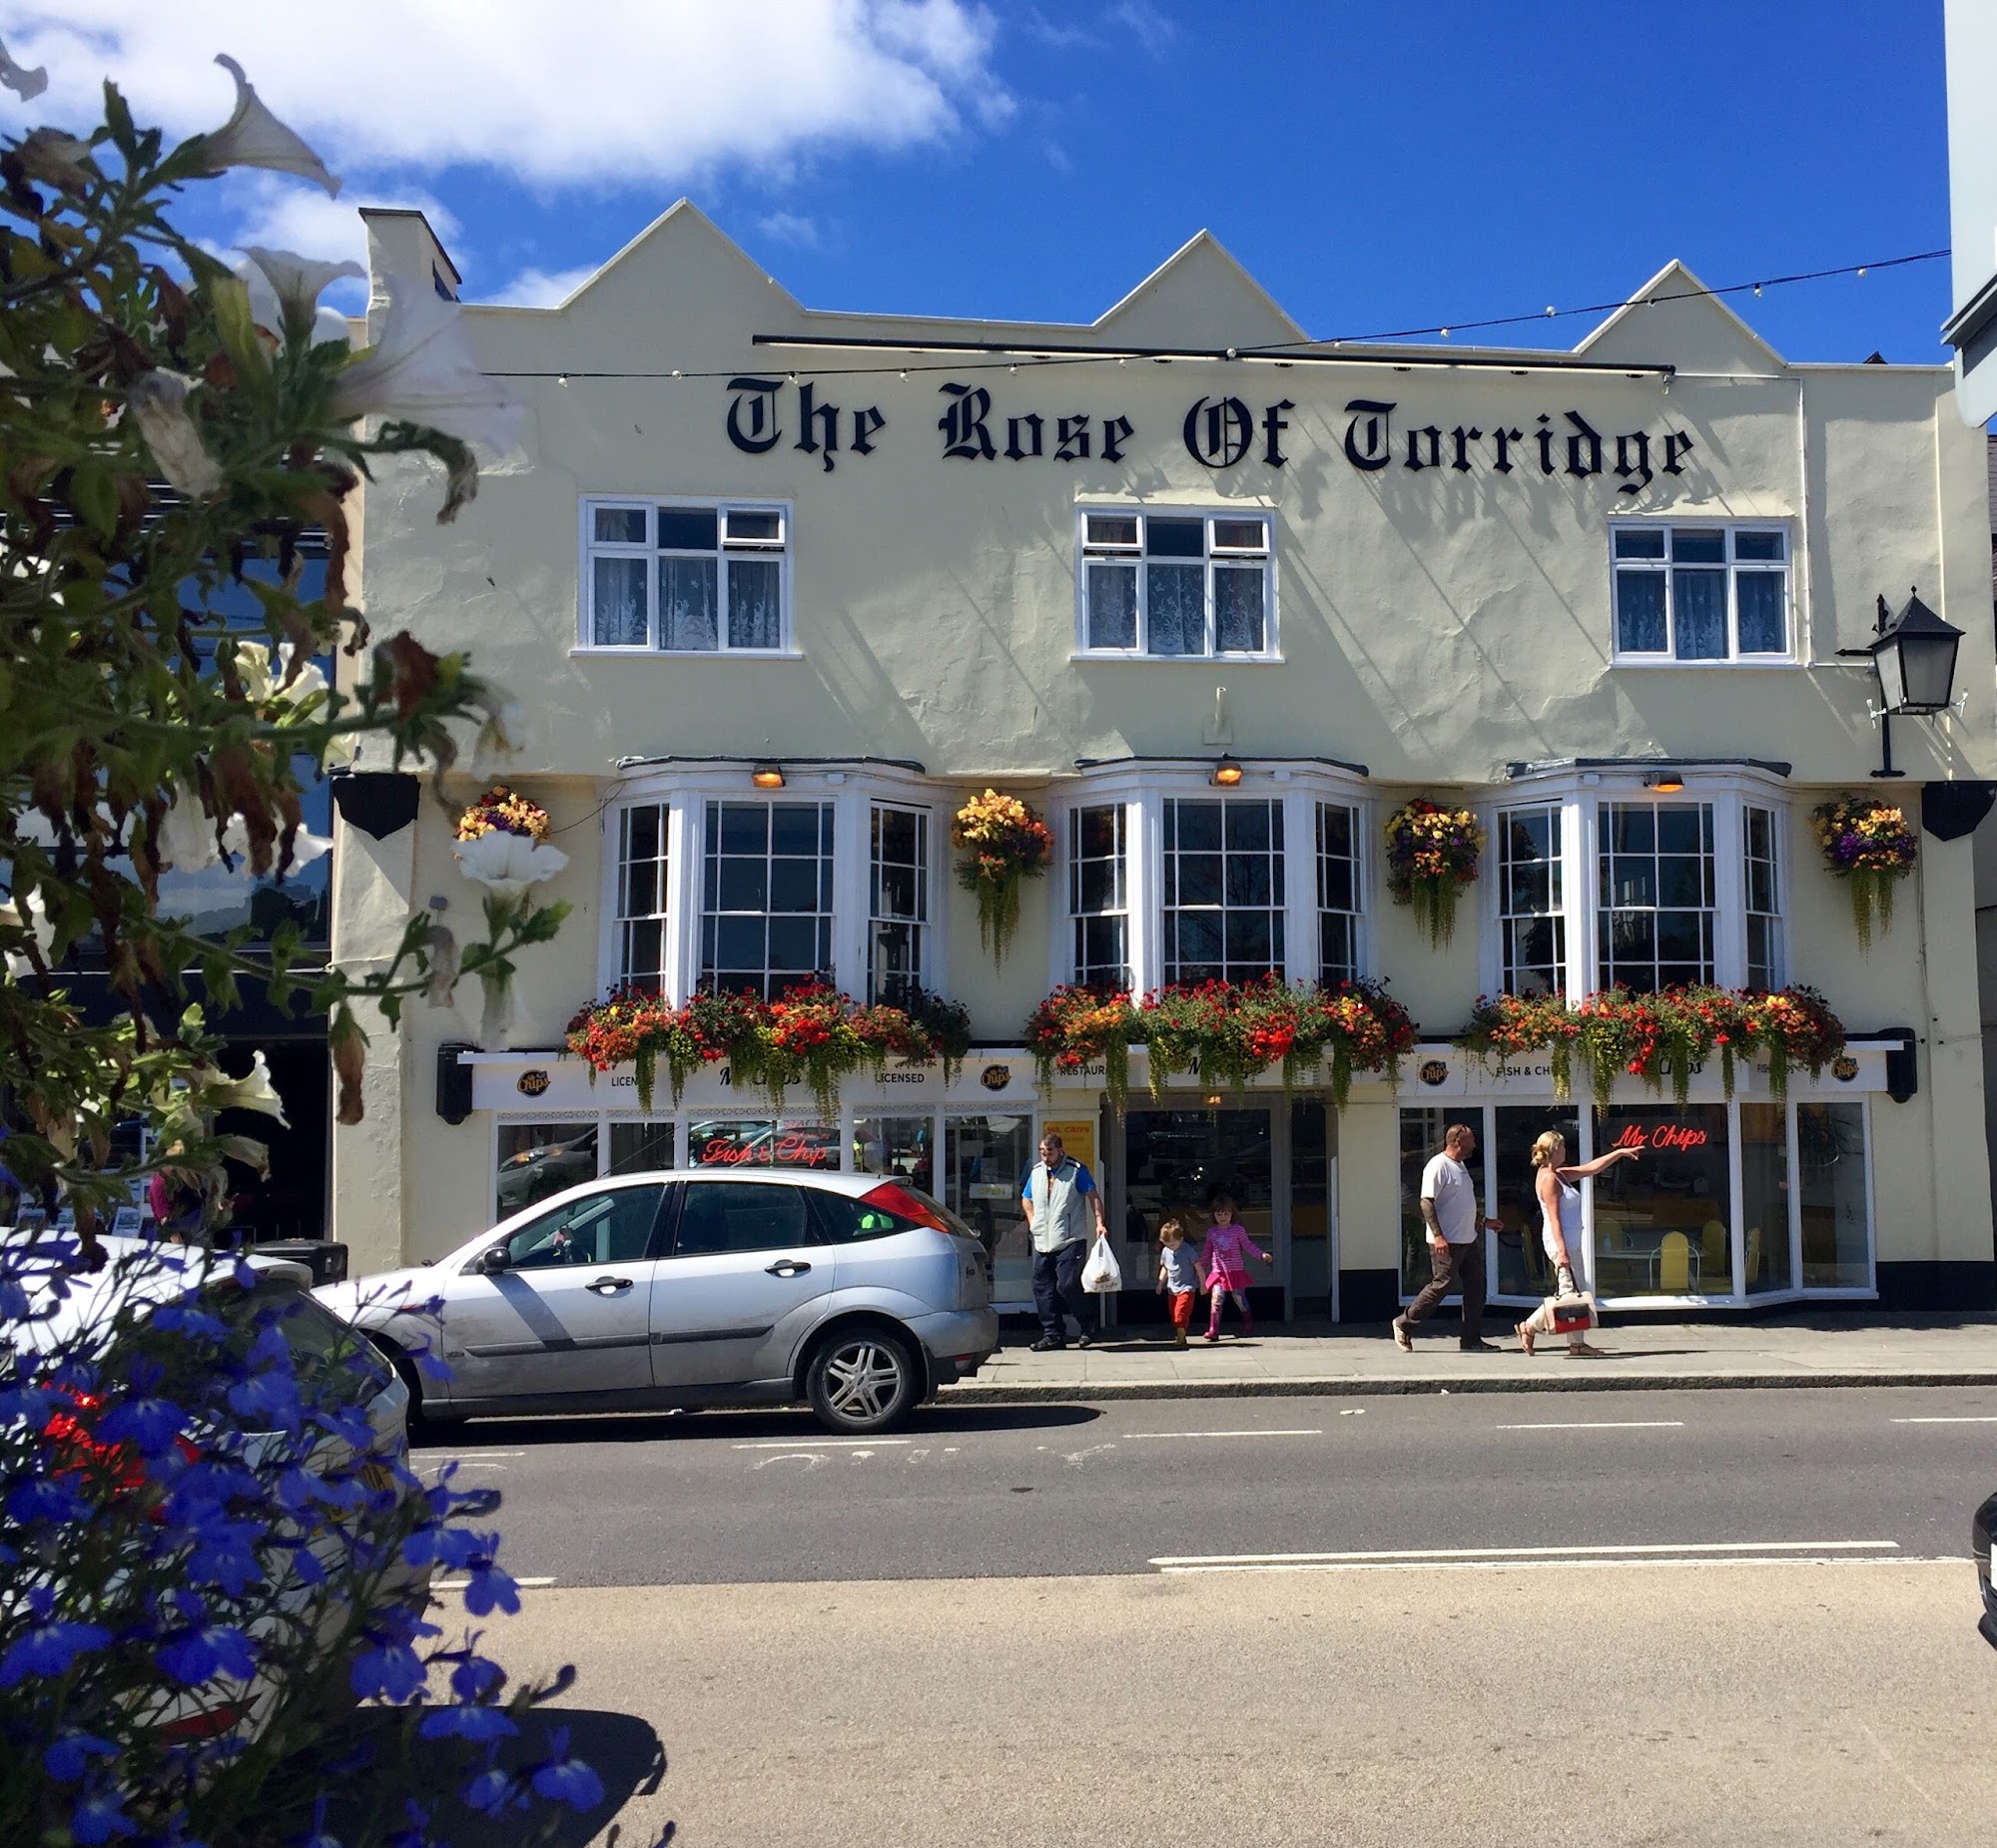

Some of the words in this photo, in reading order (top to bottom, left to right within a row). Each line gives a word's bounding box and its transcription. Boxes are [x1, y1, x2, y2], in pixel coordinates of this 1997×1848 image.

[726, 374, 887, 473] The
[938, 382, 1136, 464] Rose
[1182, 395, 1297, 469] Of
[1344, 399, 1694, 496] Torridge
[1059, 1064, 1106, 1076] RESTAUR
[1419, 1067, 1449, 1082] Chips
[1496, 1065, 1521, 1076] FISH
[1524, 1065, 1532, 1075] &
[517, 1077, 550, 1093] Chips
[611, 1076, 638, 1087] LICEN
[876, 1072, 925, 1084] LICENSED
[980, 1072, 1010, 1087] Chips
[1611, 1124, 1649, 1148] Mr
[1652, 1124, 1707, 1152] Chips
[702, 1138, 754, 1164] Fish
